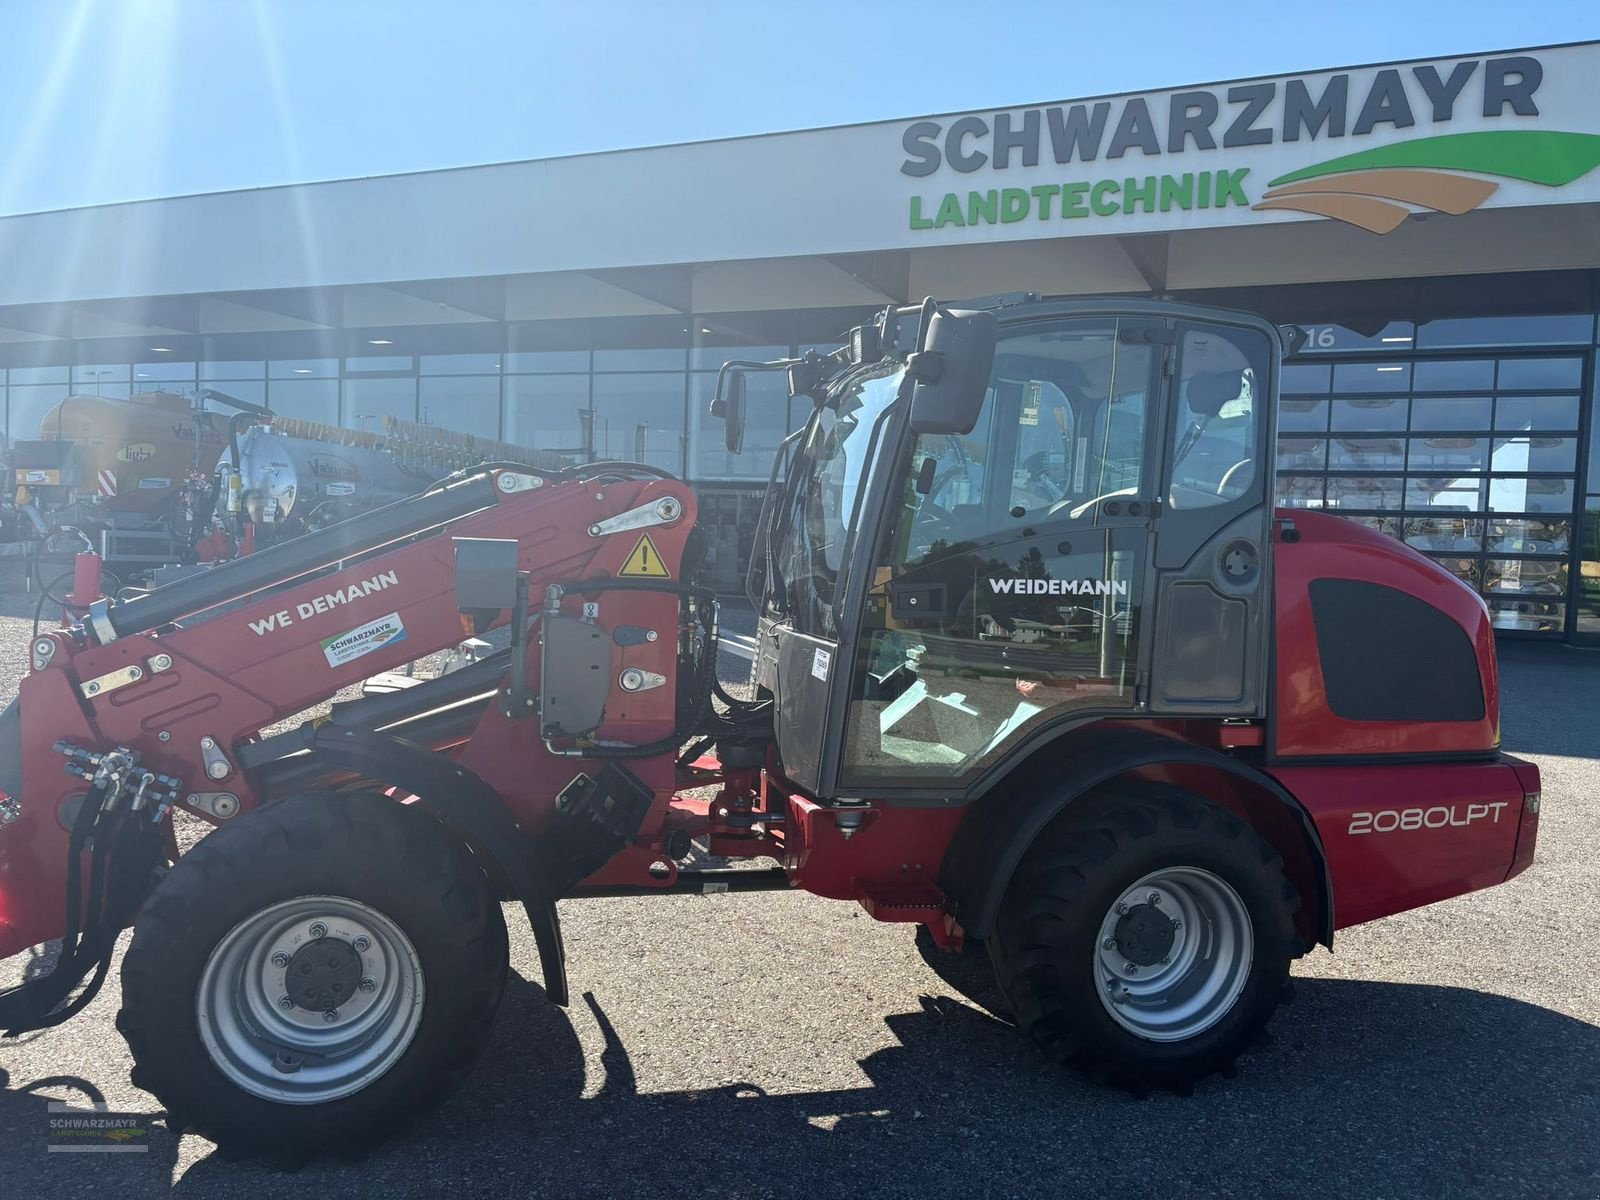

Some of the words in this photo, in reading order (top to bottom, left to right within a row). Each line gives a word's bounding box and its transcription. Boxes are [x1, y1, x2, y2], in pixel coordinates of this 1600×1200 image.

[900, 55, 1545, 178] SCHWARZMAYR
[910, 167, 1252, 231] LANDTECHNIK
[1306, 327, 1335, 348] 16
[247, 609, 293, 637] WE
[296, 569, 399, 620] DEMANN
[989, 578, 1127, 596] WEIDEMANN
[330, 623, 391, 651] SCHWARZMAYR
[1348, 801, 1508, 835] 2080LPT
